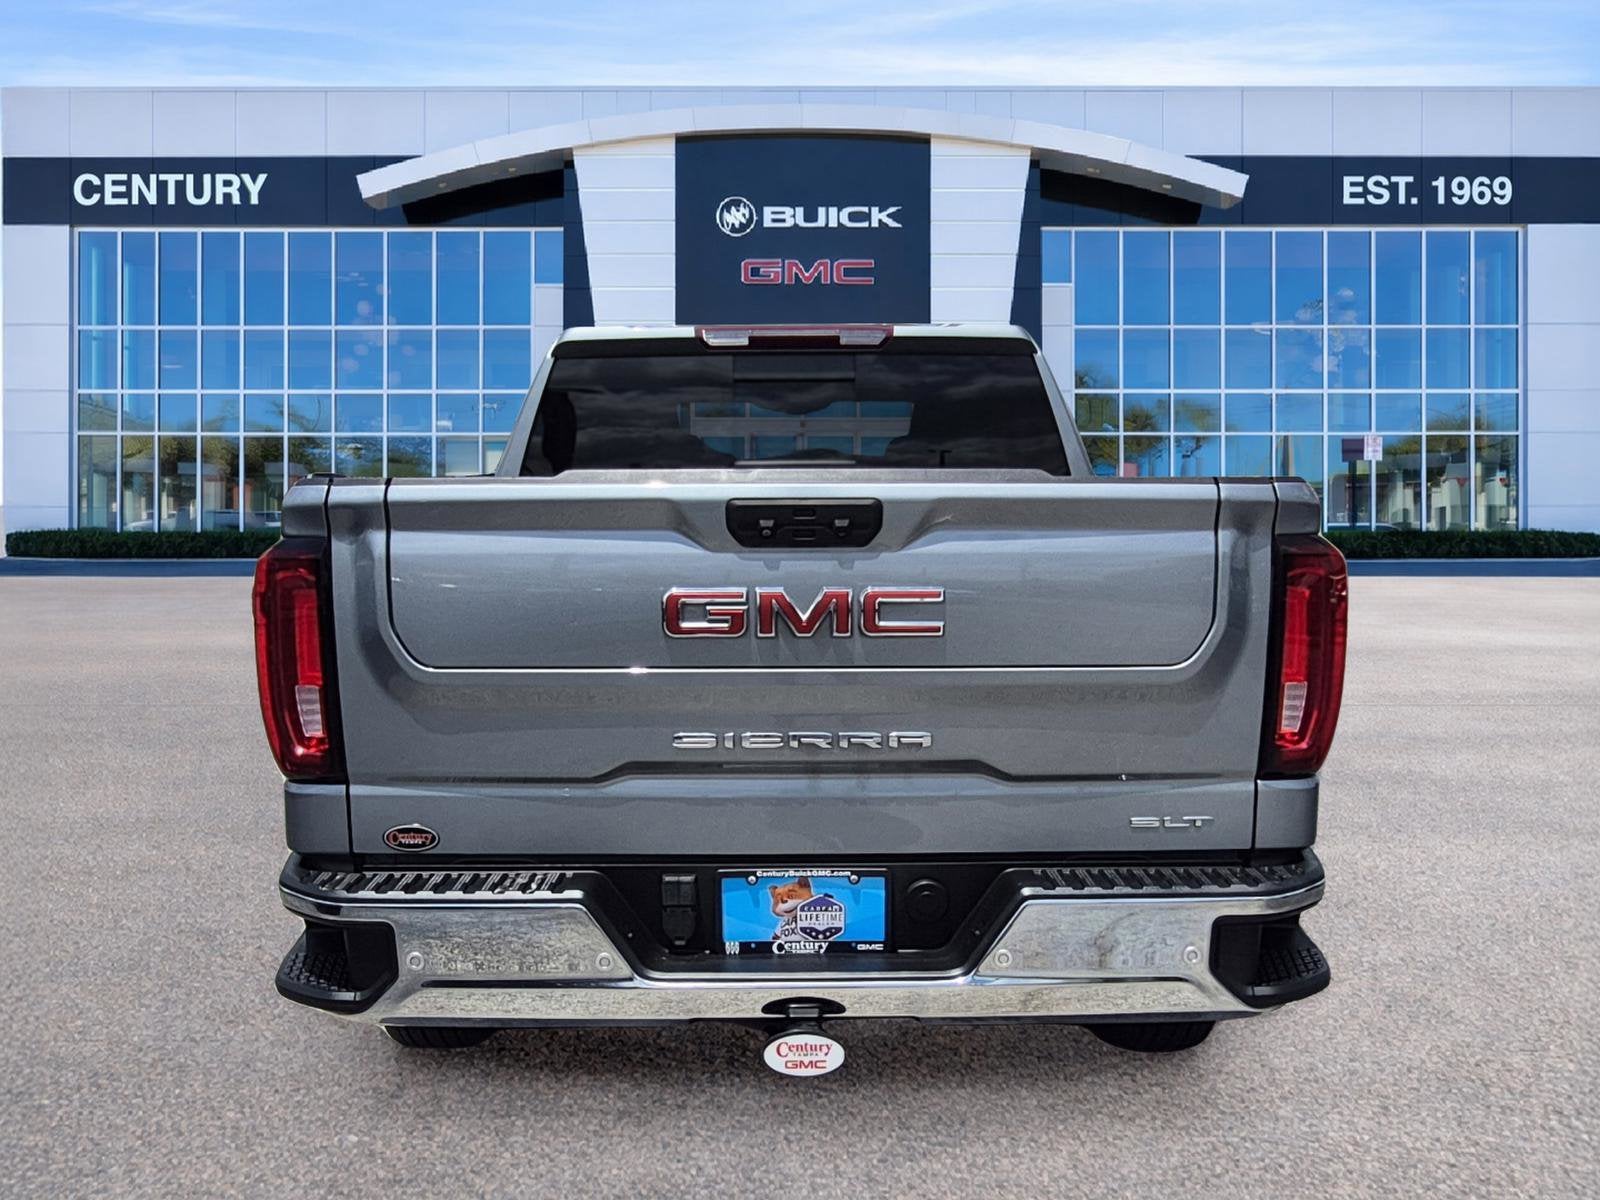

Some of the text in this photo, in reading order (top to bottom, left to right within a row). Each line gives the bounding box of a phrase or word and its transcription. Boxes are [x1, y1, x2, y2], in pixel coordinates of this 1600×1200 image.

[73, 172, 268, 206] CENTURY
[1342, 174, 1513, 206] EST. 1969
[762, 206, 903, 228] BUICK
[740, 258, 875, 285] GMC
[662, 586, 945, 638] GMC
[672, 731, 933, 749] SIERRA
[1129, 816, 1214, 828] SLT
[799, 913, 843, 922] LIFETIME
[772, 940, 828, 954] Century
[776, 1041, 833, 1058] Century
[784, 1060, 827, 1069] GMC
